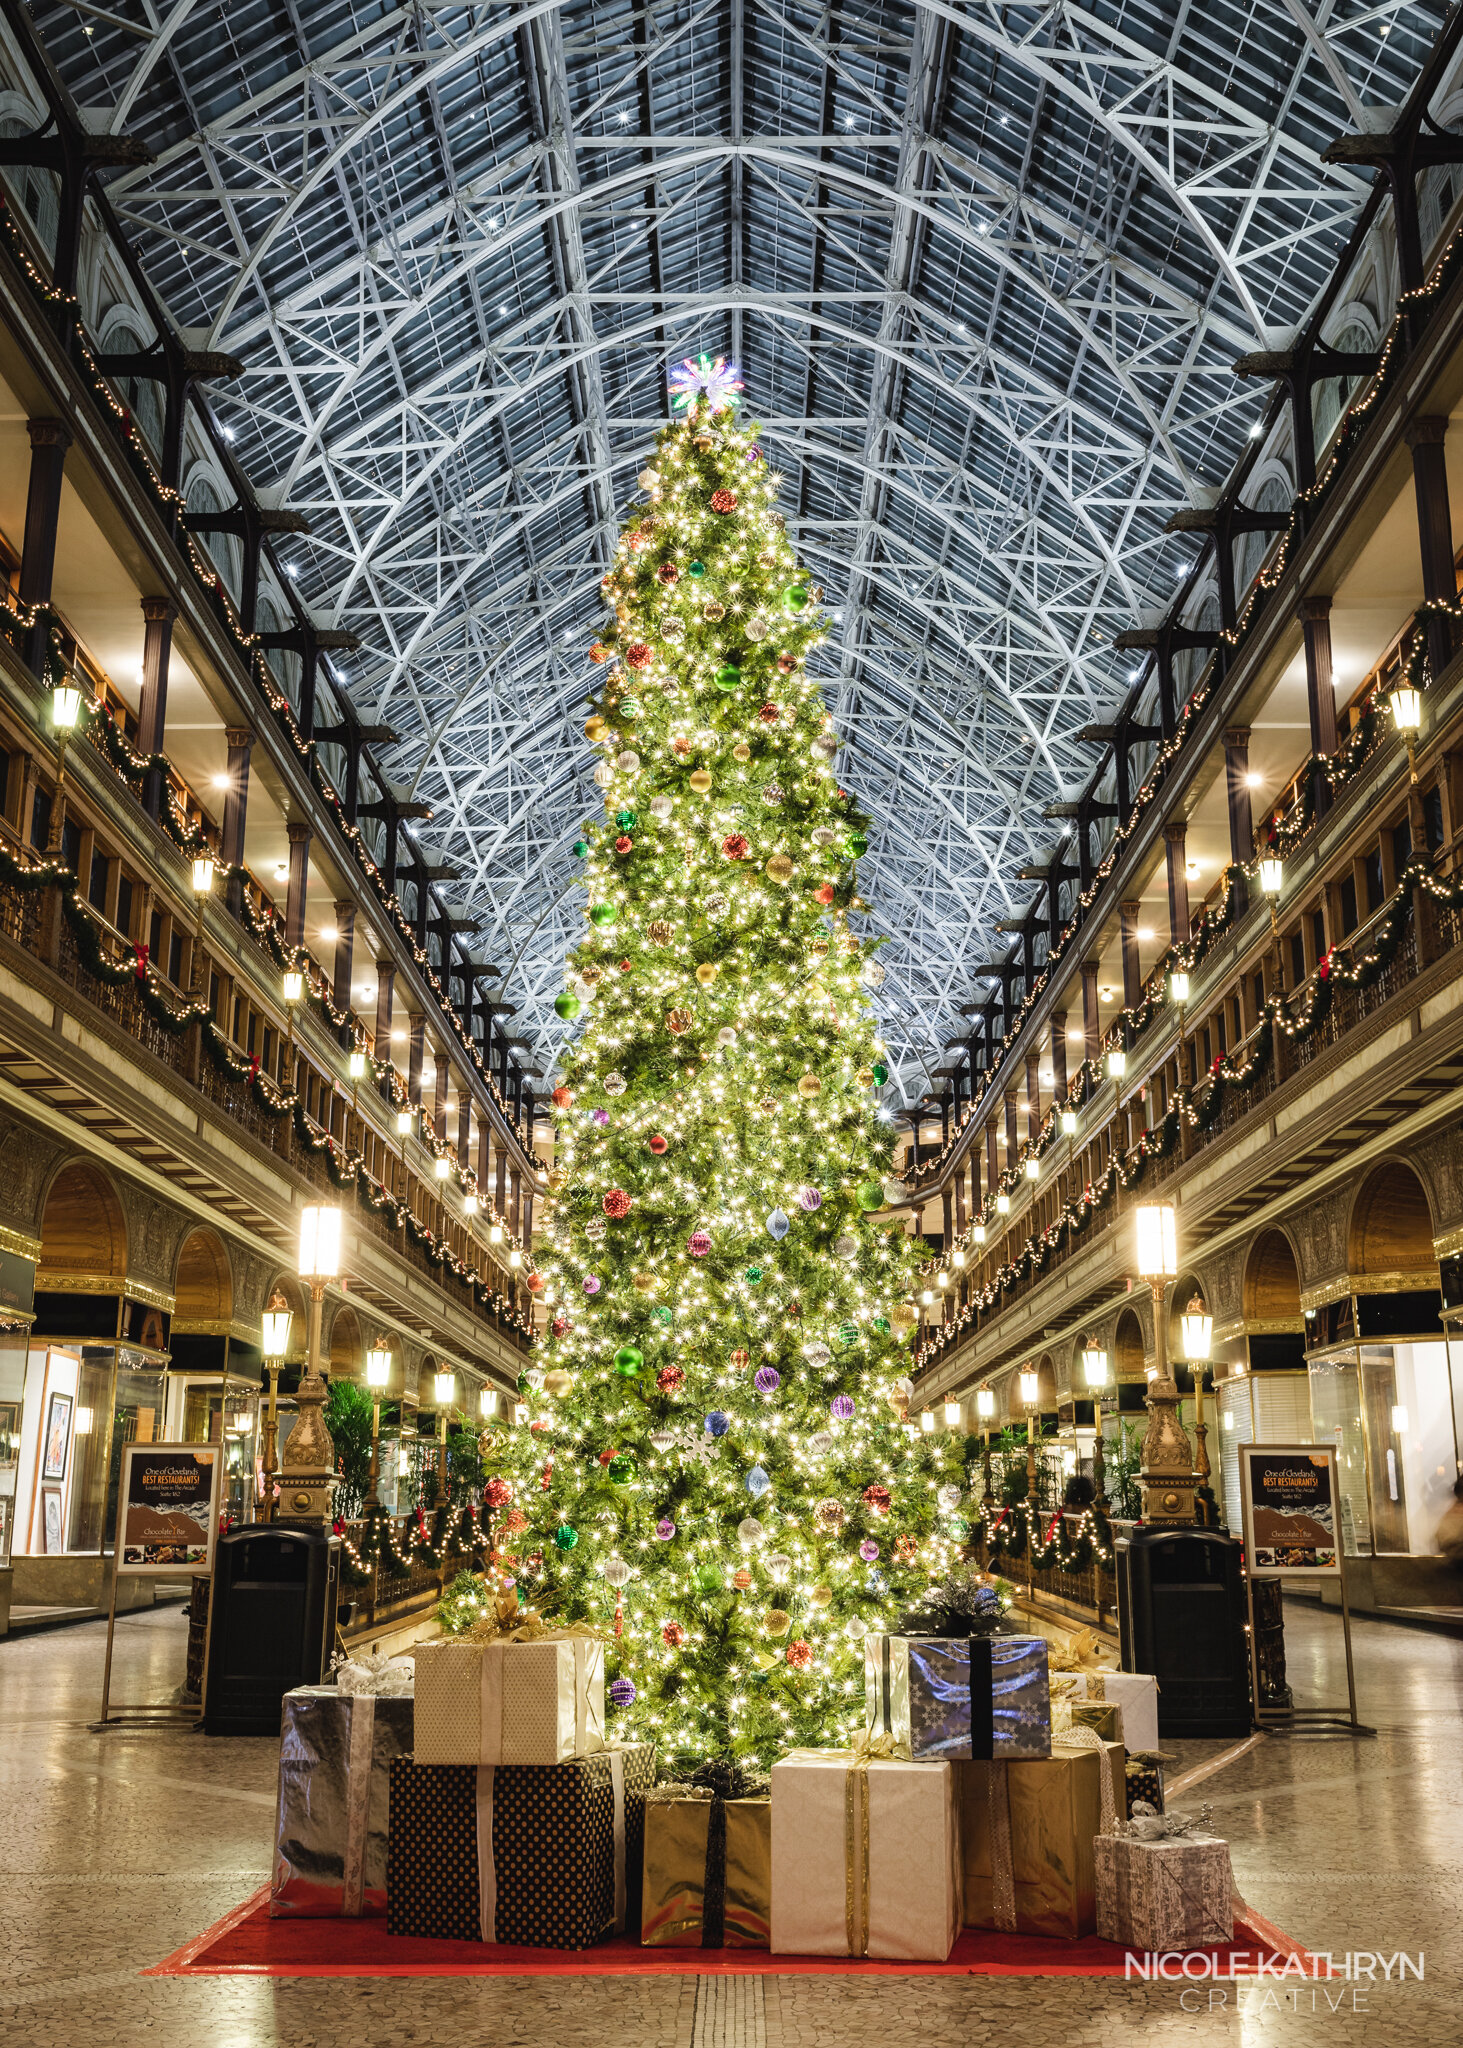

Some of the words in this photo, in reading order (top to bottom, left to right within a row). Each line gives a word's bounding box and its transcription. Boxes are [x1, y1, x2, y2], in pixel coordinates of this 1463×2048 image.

[160, 1467, 168, 1475] of
[1264, 1469, 1278, 1477] One
[1278, 1469, 1286, 1477] of
[142, 1475, 157, 1484] BEST
[158, 1475, 200, 1484] RESTAURANTS!
[1263, 1477, 1277, 1486] BEST
[1277, 1477, 1318, 1486] RESTAURANTS!
